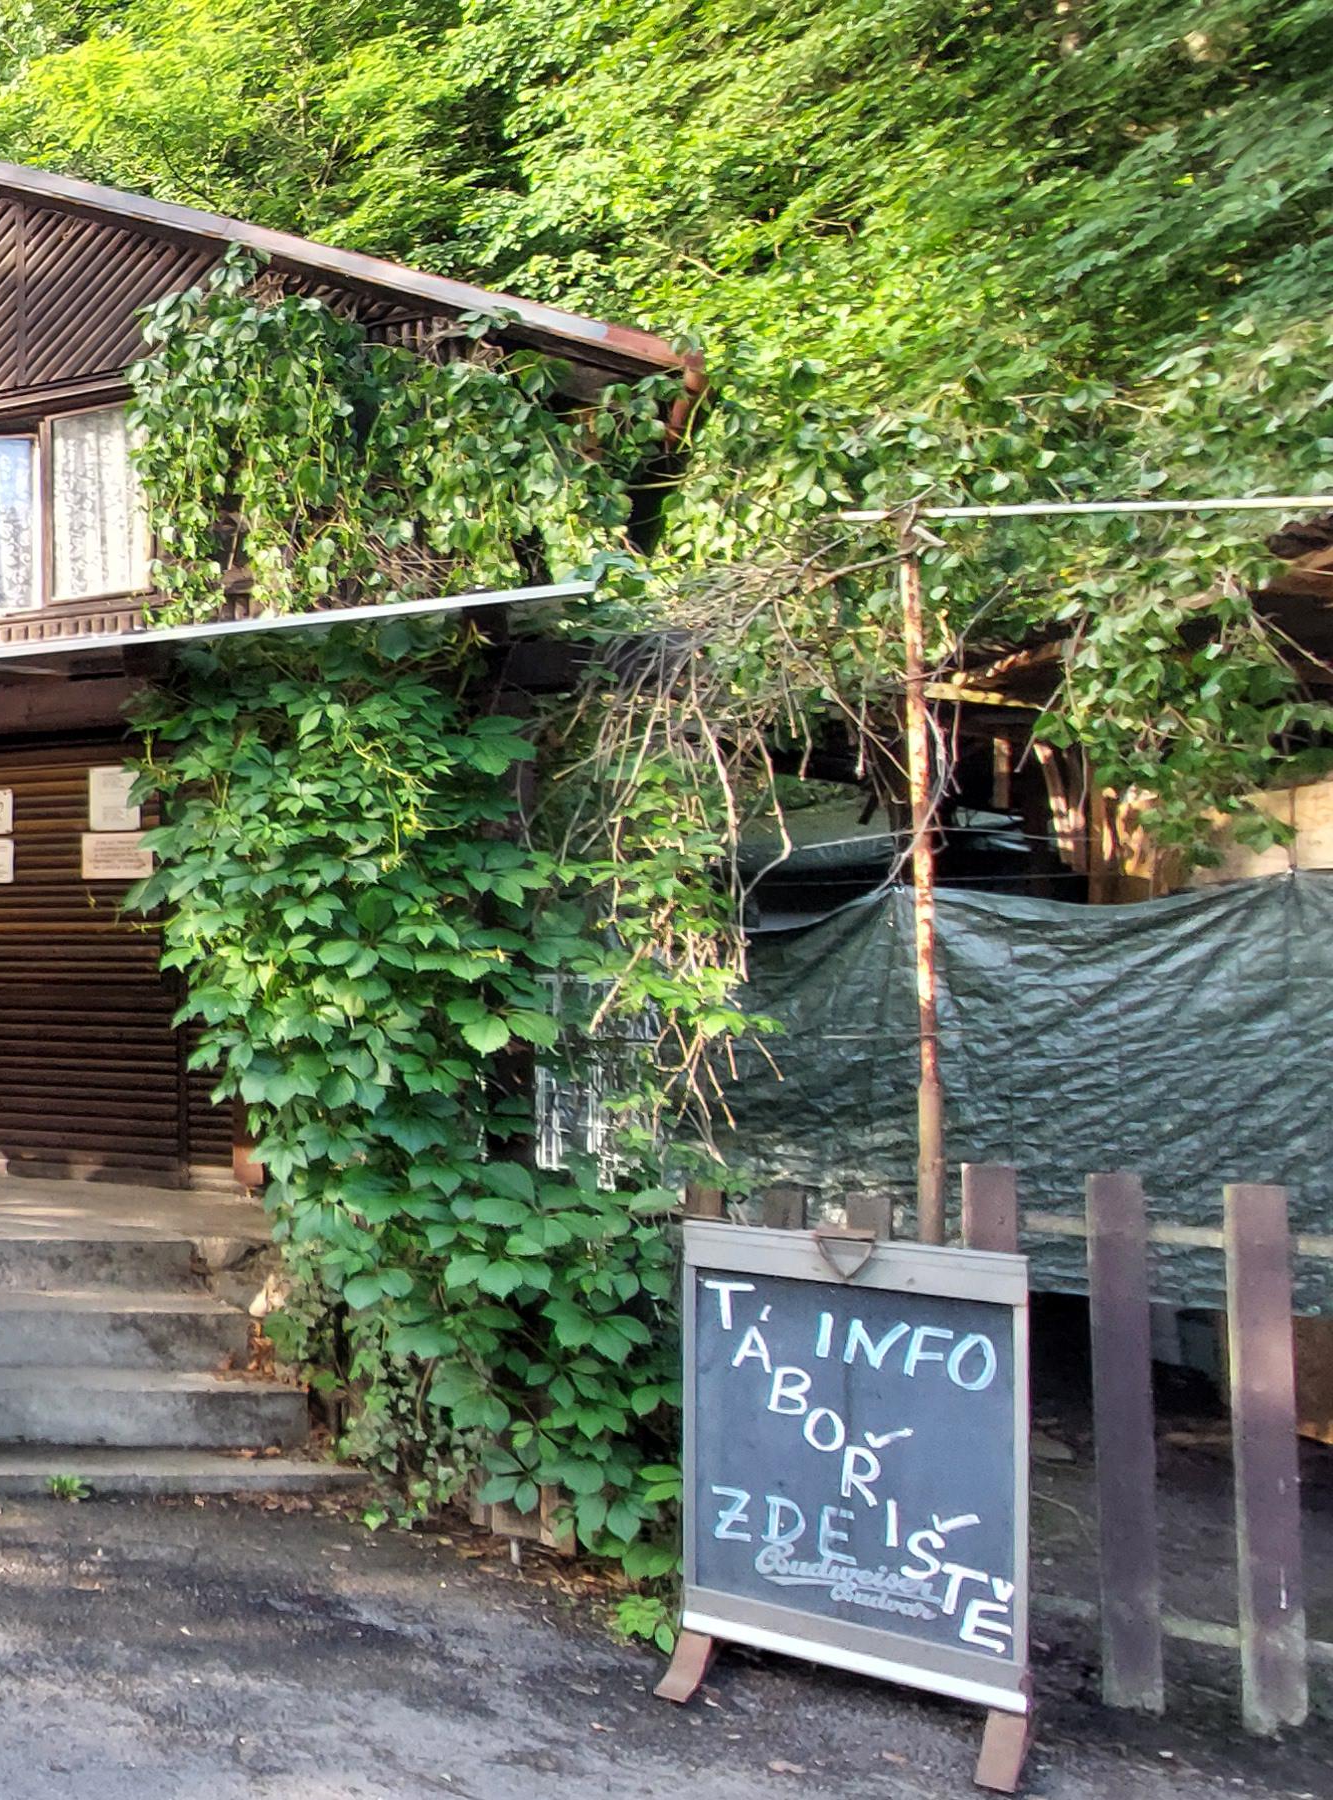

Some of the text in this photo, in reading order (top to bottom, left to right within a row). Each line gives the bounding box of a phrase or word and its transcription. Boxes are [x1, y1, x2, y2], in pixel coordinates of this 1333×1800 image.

[815, 1311, 998, 1391] INFO
[711, 1485, 858, 1566] ZDE
[754, 1542, 935, 1597] Budweiser
[830, 1582, 938, 1621] Budvar
